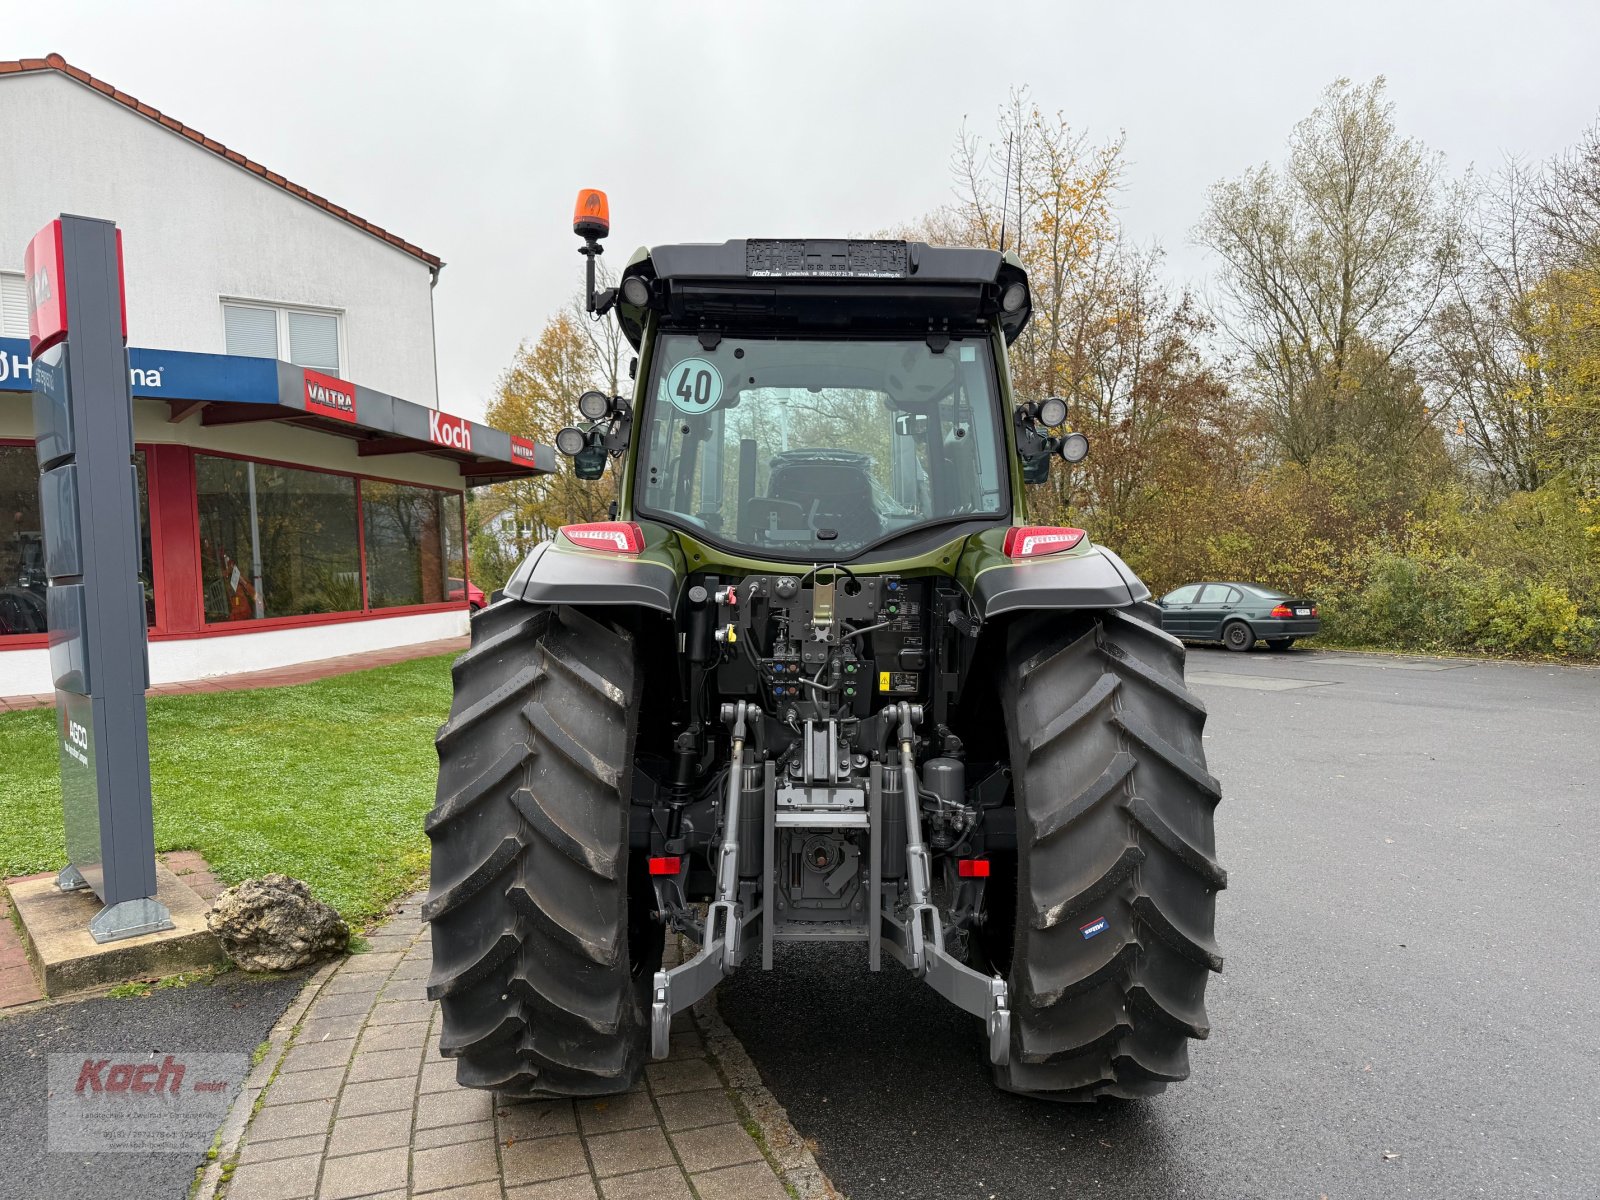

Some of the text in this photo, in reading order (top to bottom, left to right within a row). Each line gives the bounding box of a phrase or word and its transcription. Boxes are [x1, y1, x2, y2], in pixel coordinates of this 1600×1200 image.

[306, 379, 354, 413] VALTRA
[676, 368, 712, 404] 40
[428, 409, 471, 450] Koch
